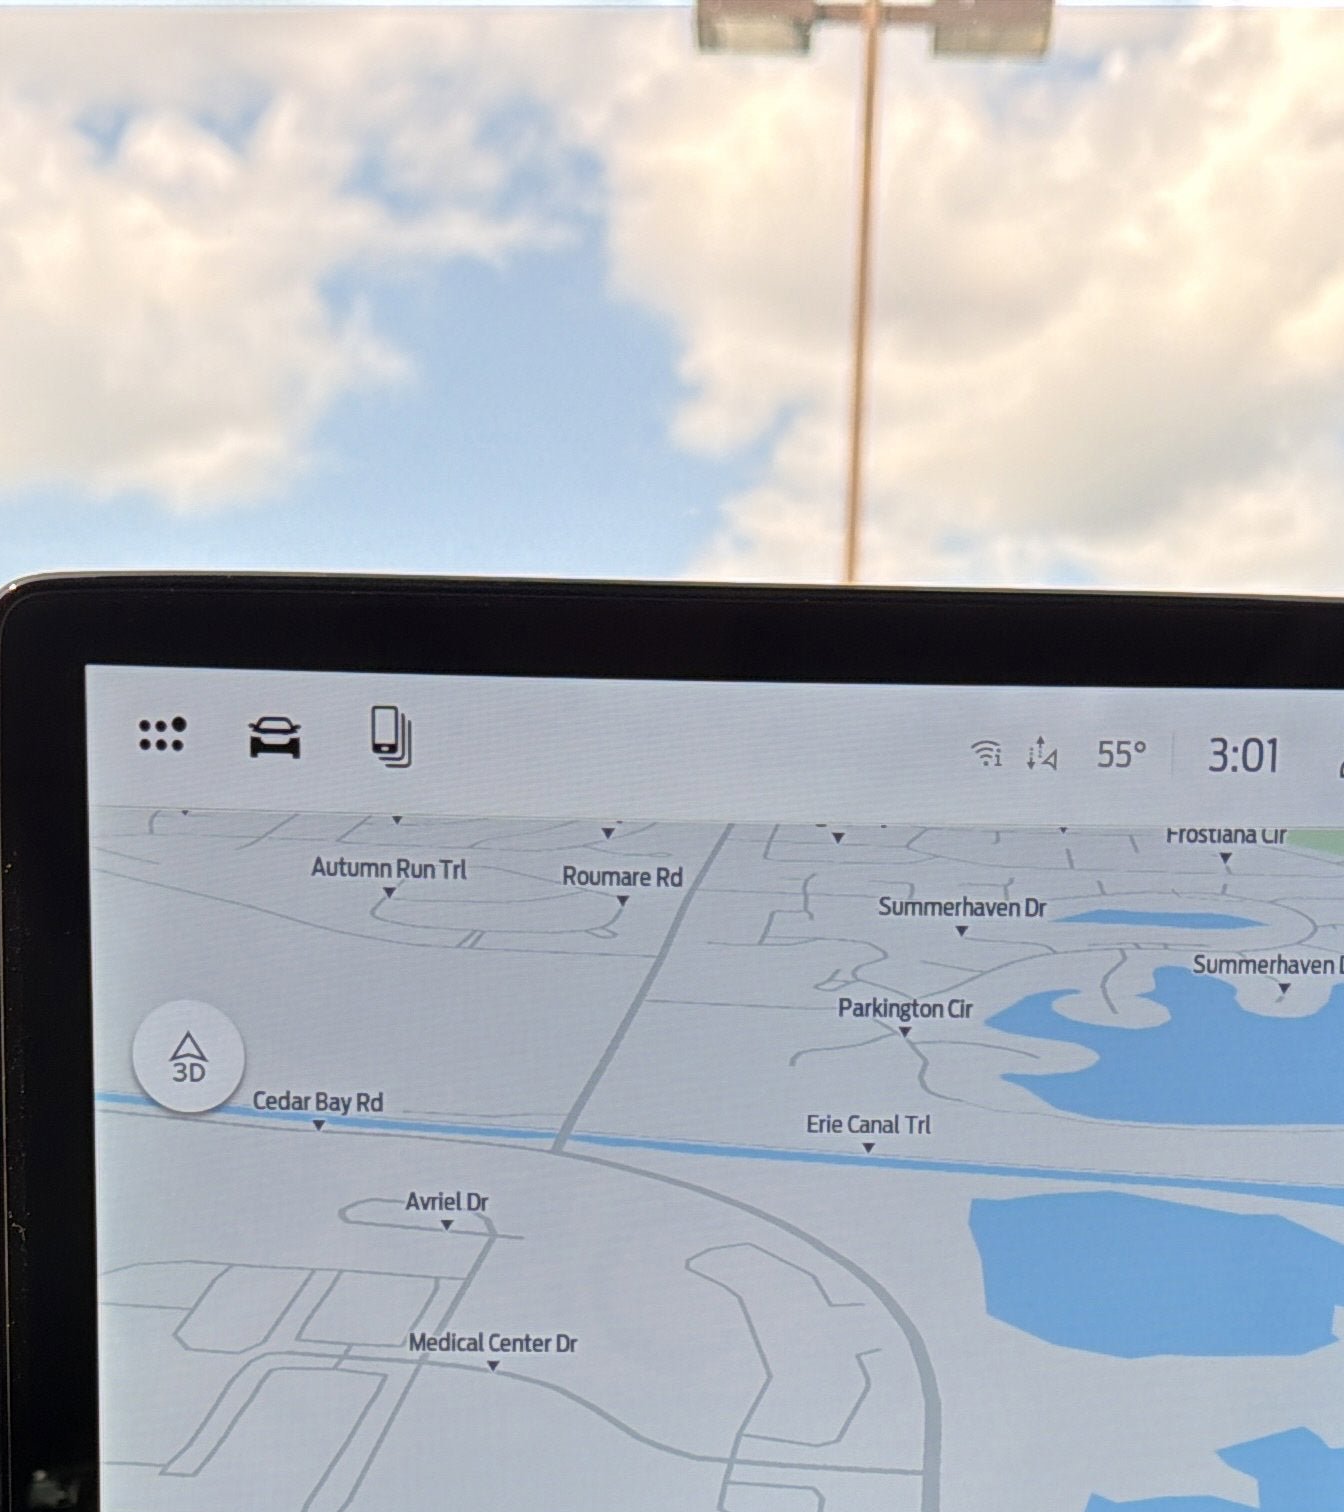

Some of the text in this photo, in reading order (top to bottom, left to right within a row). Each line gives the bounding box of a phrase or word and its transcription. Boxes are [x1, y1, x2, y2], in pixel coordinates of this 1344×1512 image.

[1097, 740, 1147, 768] 55°
[1208, 737, 1280, 773] 3:01
[1261, 828, 1288, 845] Cir
[310, 855, 468, 881] Autumn Run Trl
[562, 865, 684, 888] Roumare Rd
[878, 895, 1048, 918] Summerhaven Dr
[1190, 953, 1335, 977] Summerhaven
[838, 996, 974, 1023] Parkington Cir
[172, 1060, 209, 1083] 3D
[253, 1089, 384, 1117] Cedar Bay Rd
[806, 1113, 932, 1135] Erie Canal Trl
[404, 1190, 489, 1212] Avriel Dr
[409, 1331, 579, 1353] Medical Center Dr
